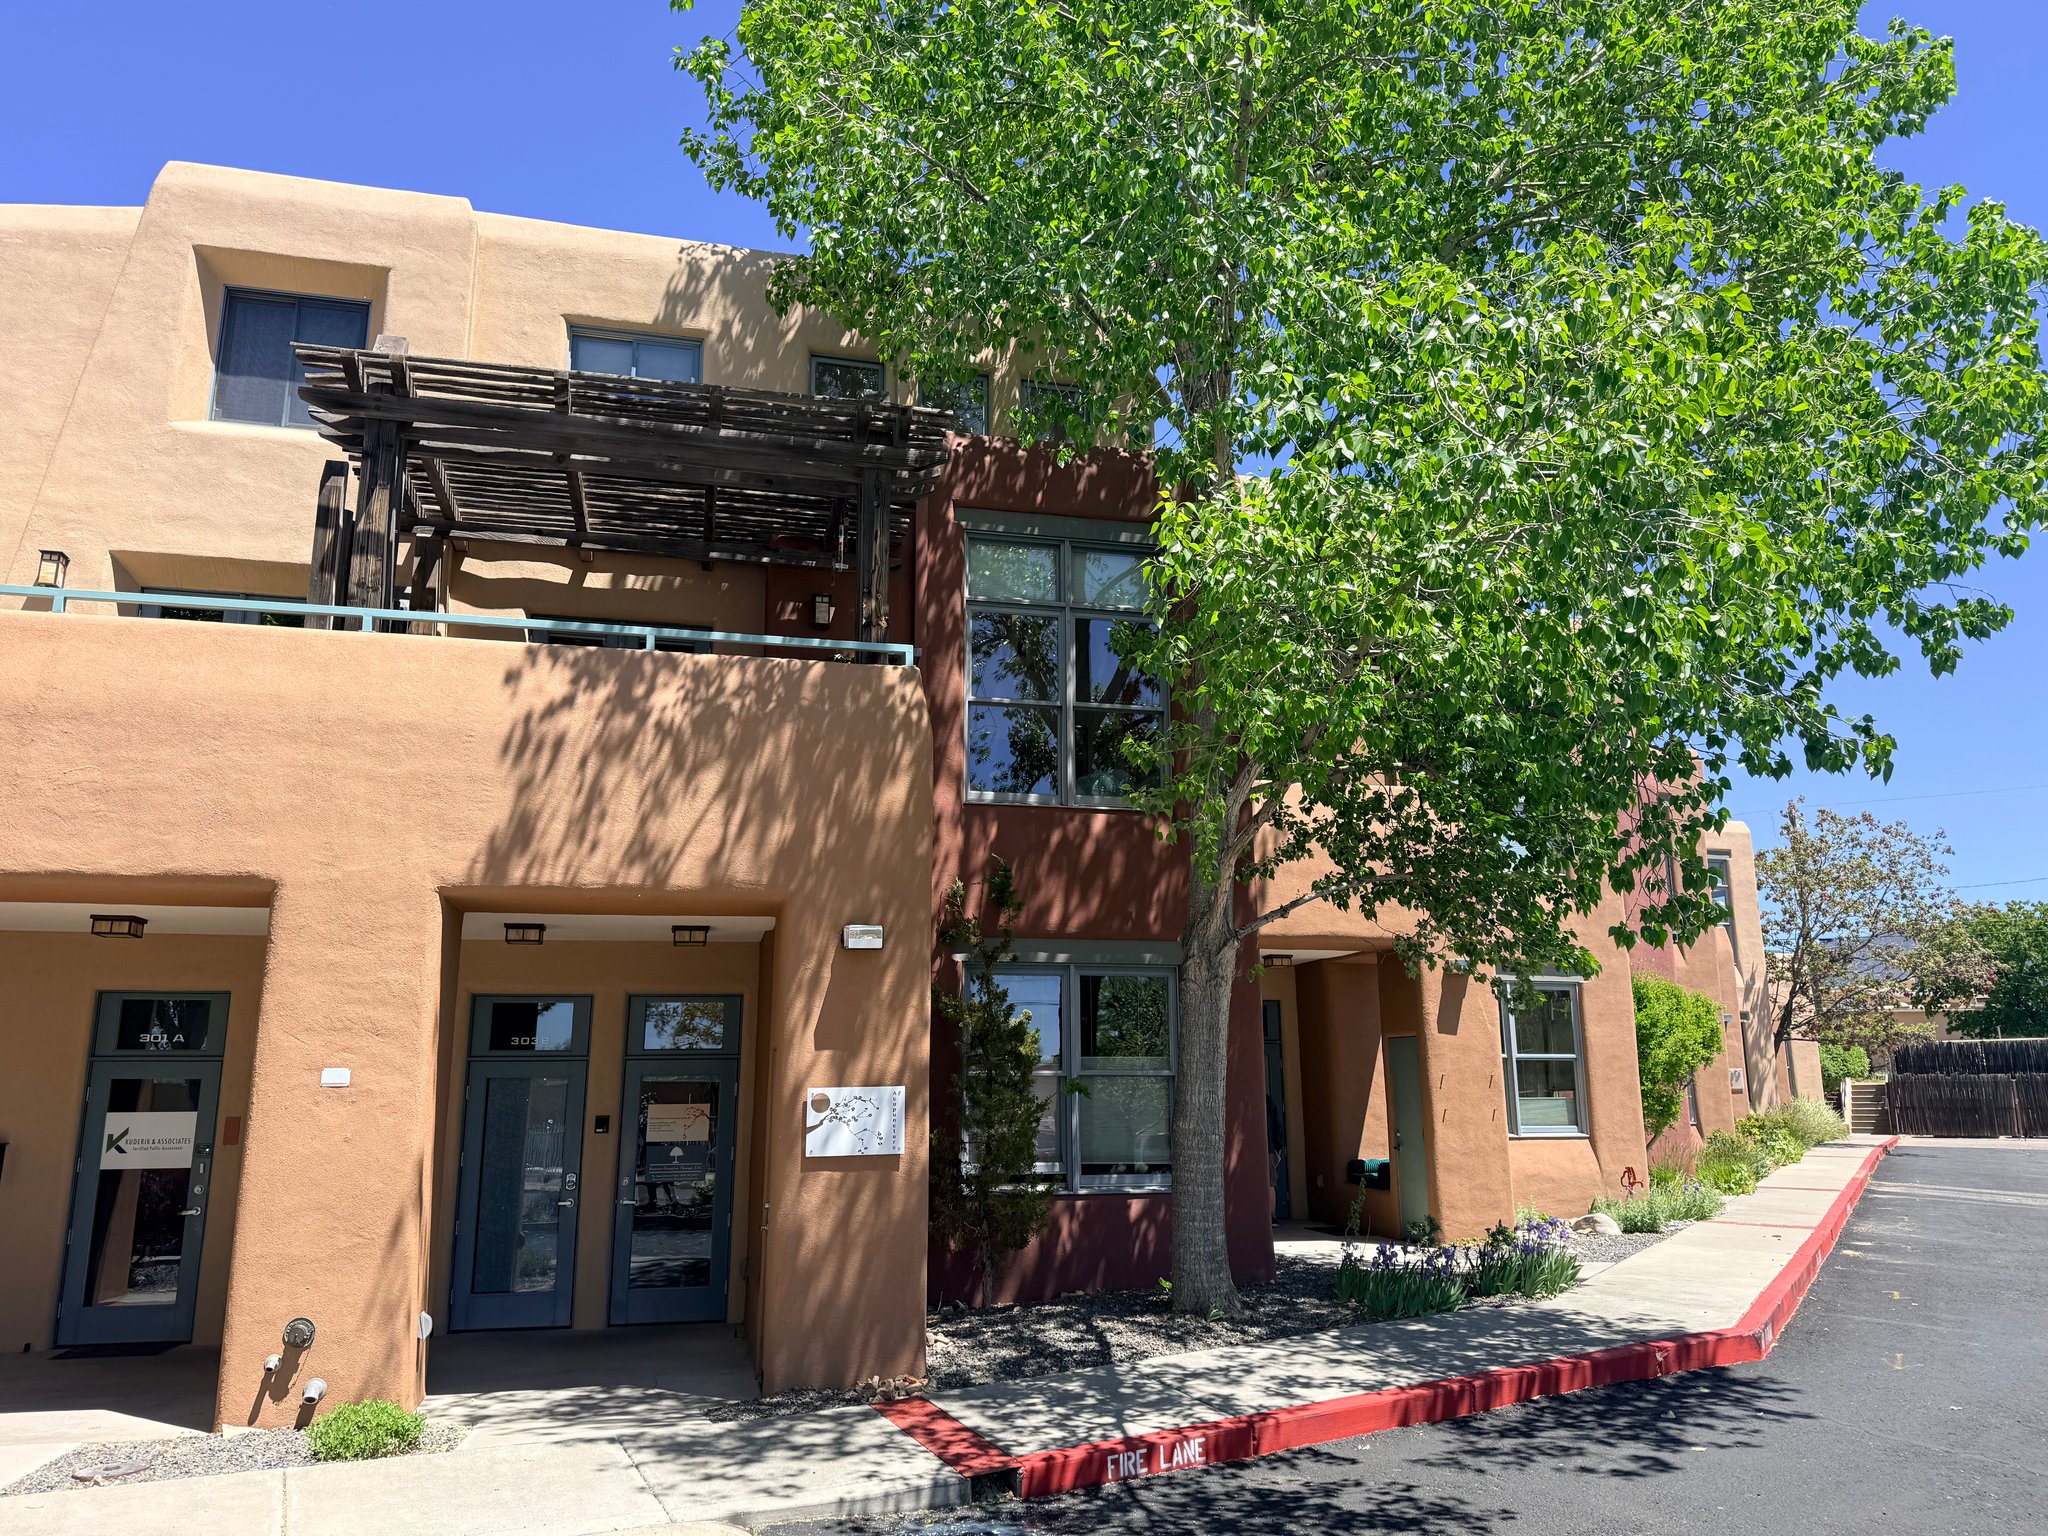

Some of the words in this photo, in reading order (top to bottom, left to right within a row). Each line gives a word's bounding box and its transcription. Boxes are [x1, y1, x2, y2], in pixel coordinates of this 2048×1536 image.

[139, 1034, 168, 1043] 301
[172, 1033, 185, 1043] A
[510, 1037, 539, 1045] 303
[157, 1137, 191, 1145] ASSOCIATES
[1107, 1448, 1148, 1479] FIRE
[1160, 1437, 1206, 1469] LANE
